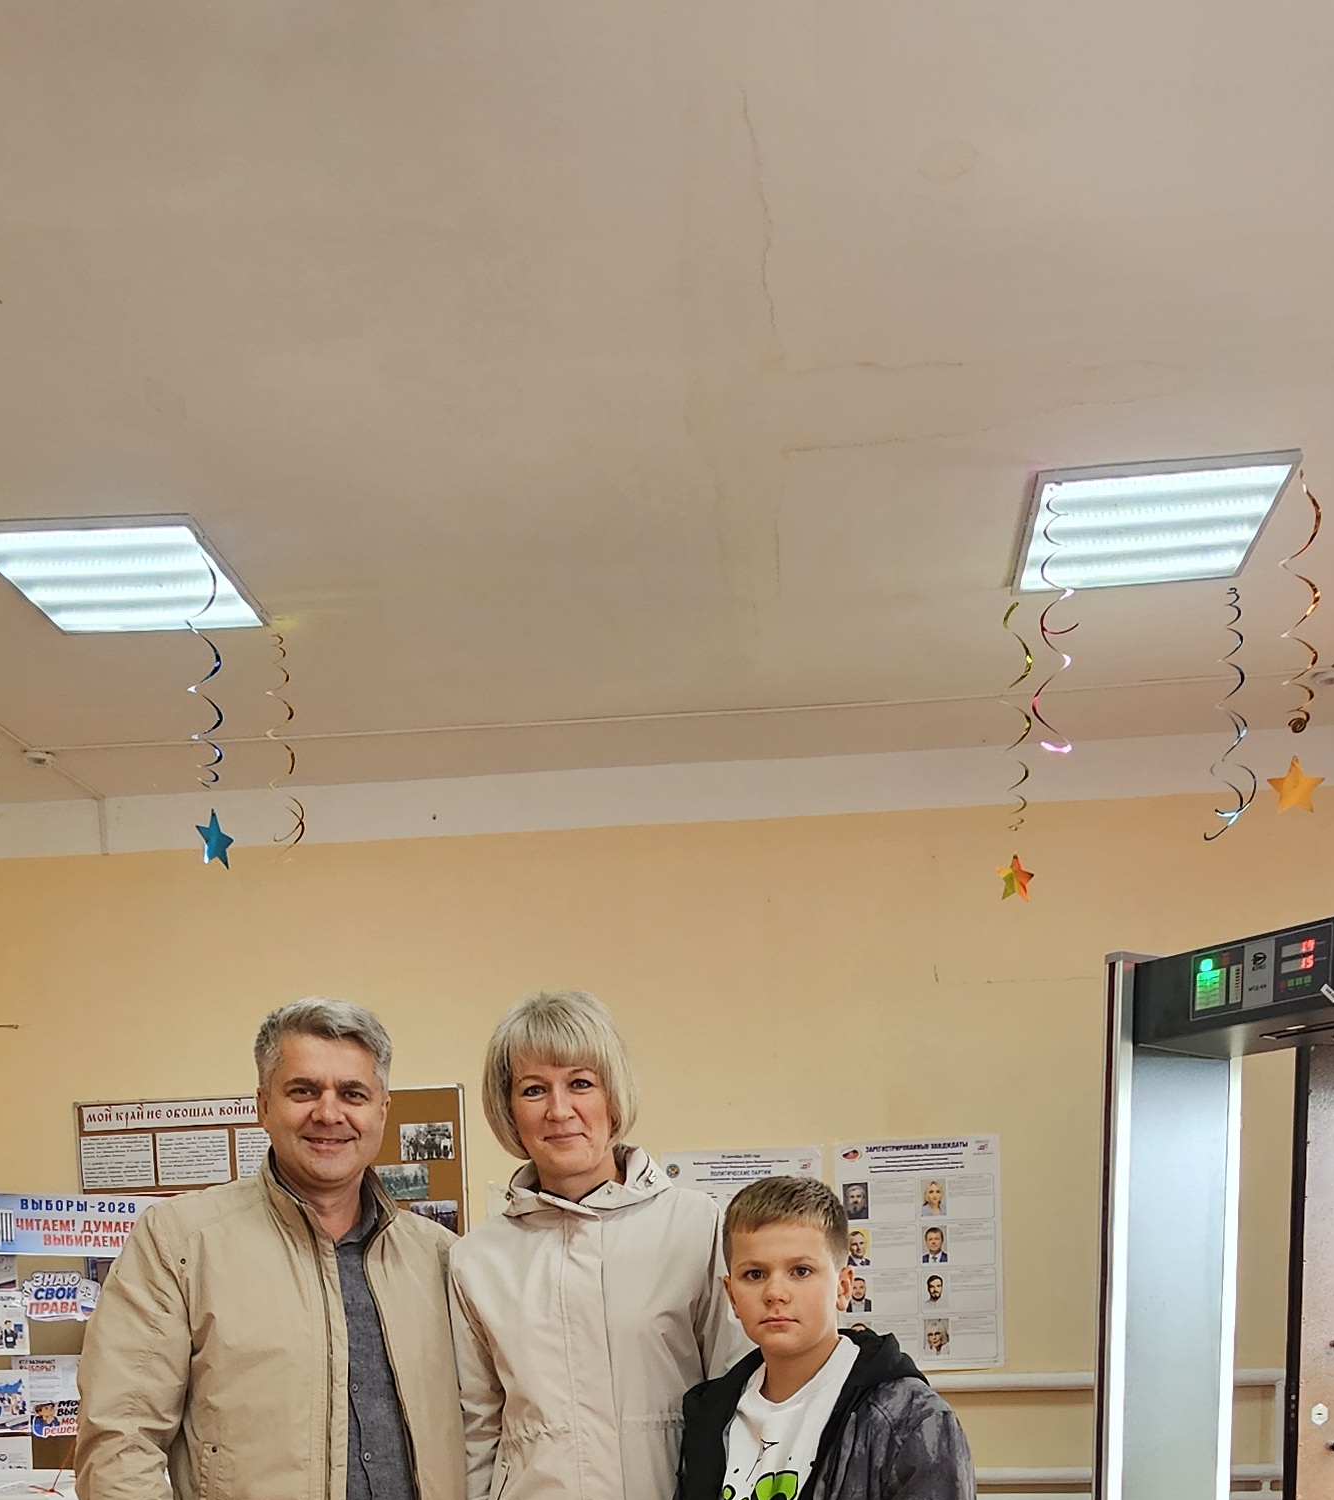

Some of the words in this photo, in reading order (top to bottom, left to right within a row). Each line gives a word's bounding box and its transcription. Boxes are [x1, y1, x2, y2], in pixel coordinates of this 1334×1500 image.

[85, 1105, 113, 1124] МОЙ
[115, 1103, 144, 1128] КРАЙ
[146, 1108, 163, 1120] НЕ
[165, 1105, 215, 1119] ОБОШЛА
[219, 1098, 258, 1118] ВОЙНА
[20, 1198, 136, 1213] ВЫБОРЫ-2026
[15, 1217, 75, 1232] ЧИТАЕМ!
[31, 1272, 81, 1287] ЗНАЮ
[33, 1287, 78, 1301] СВОИ
[28, 1301, 79, 1315] ПРАВА
[43, 1424, 79, 1437] решен
